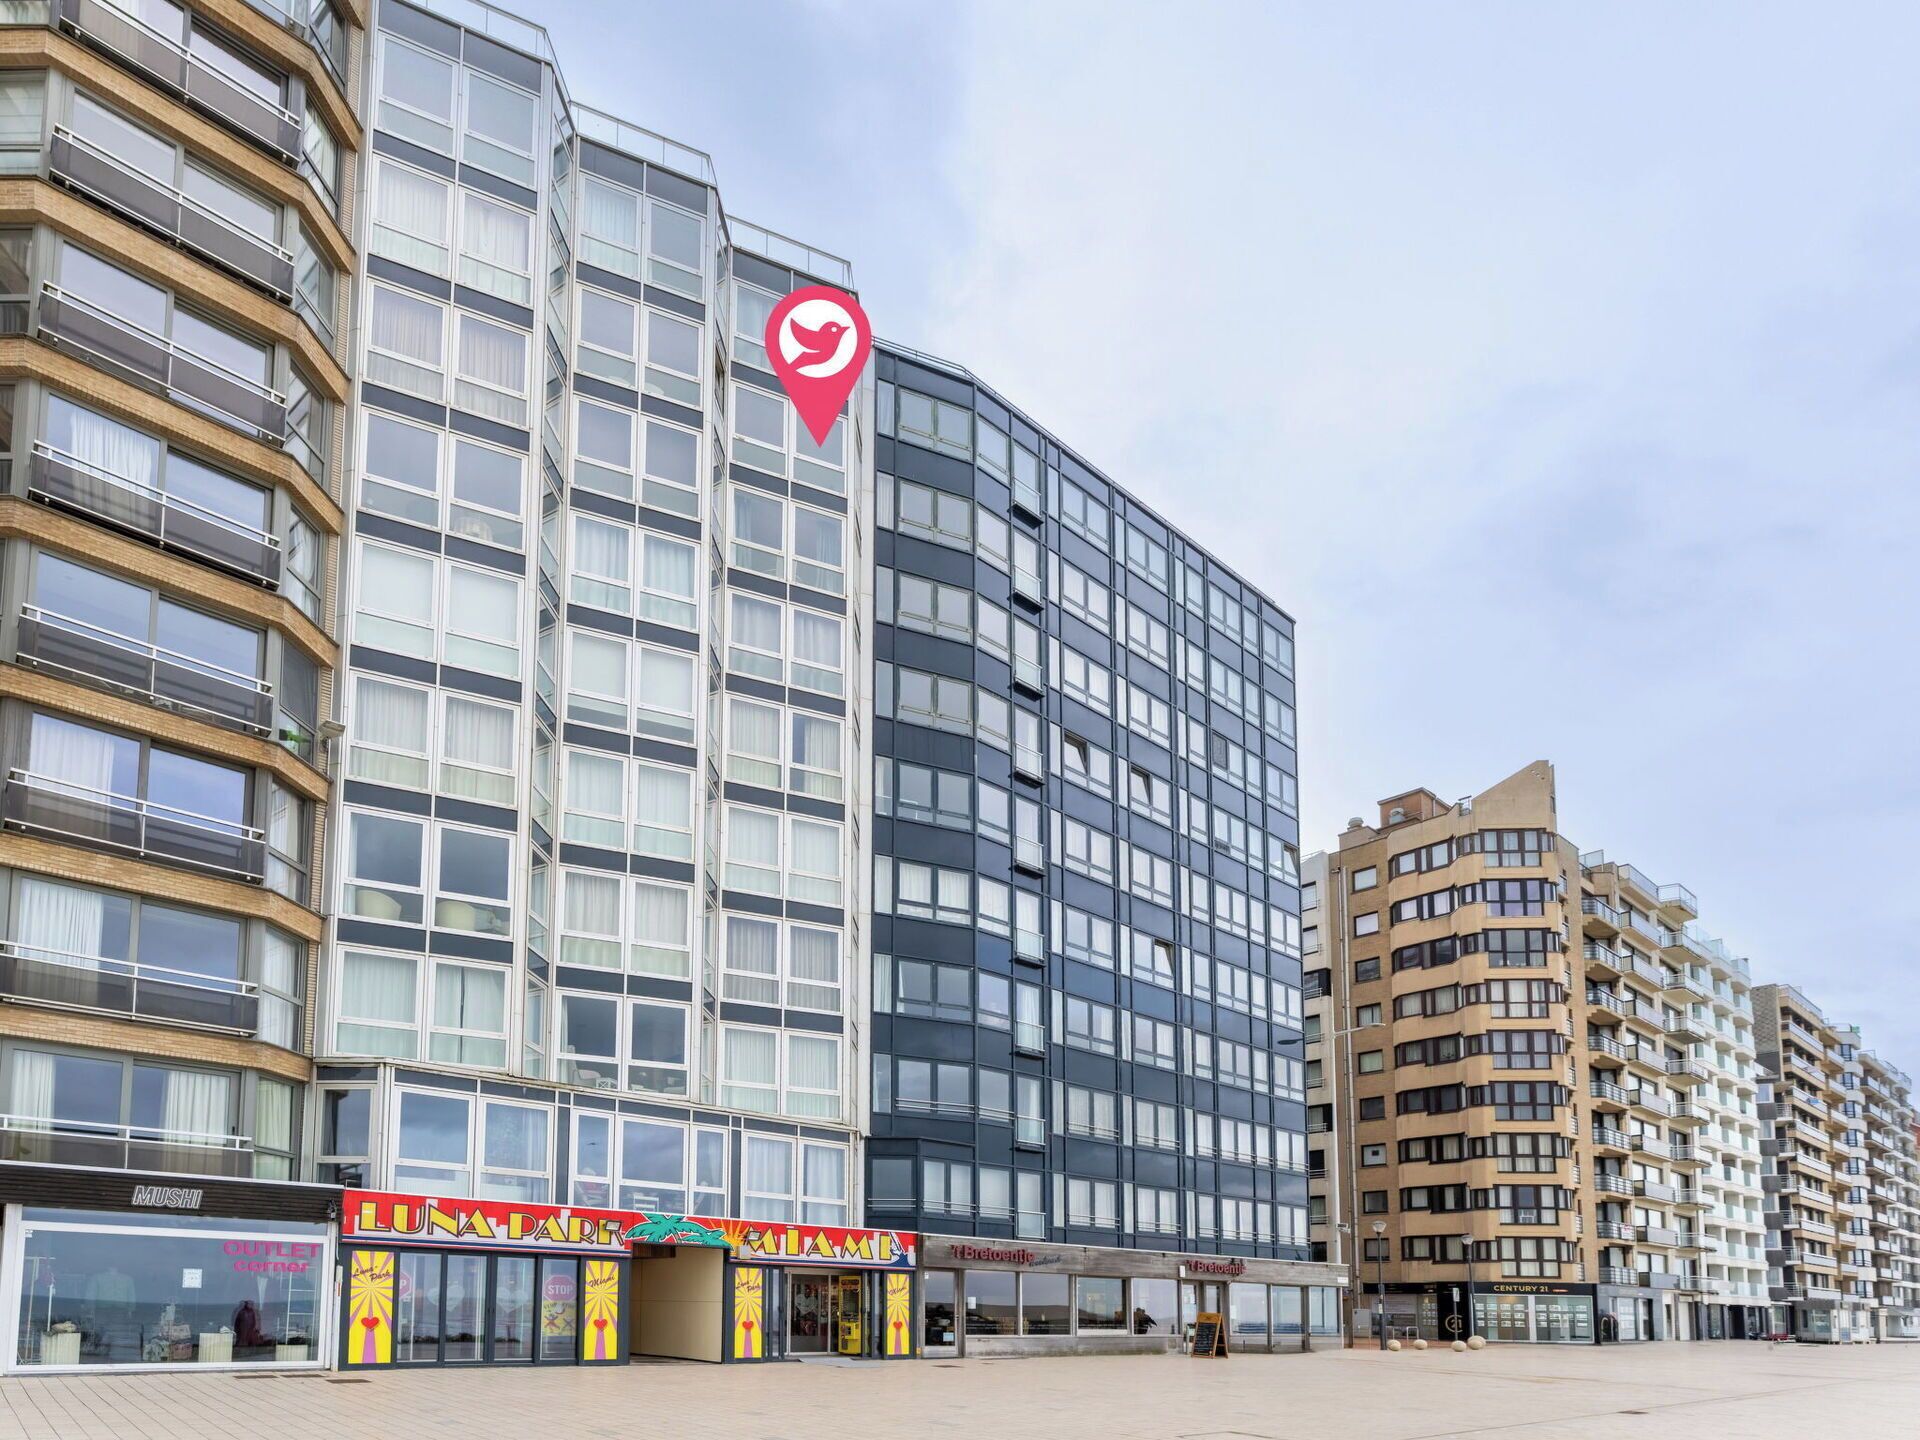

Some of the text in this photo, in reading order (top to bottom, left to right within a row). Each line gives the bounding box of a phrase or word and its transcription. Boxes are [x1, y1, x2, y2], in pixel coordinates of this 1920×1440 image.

[132, 1185, 203, 1209] MUSHI
[359, 1201, 625, 1247] LUNA PARK
[223, 1240, 321, 1258] OUTLET
[746, 1226, 893, 1261] MIAMI
[233, 1259, 310, 1273] corner
[369, 1269, 391, 1281] Park
[547, 1284, 573, 1296] STOP
[1493, 1284, 1537, 1293] CENTURY
[1539, 1285, 1548, 1293] 21
